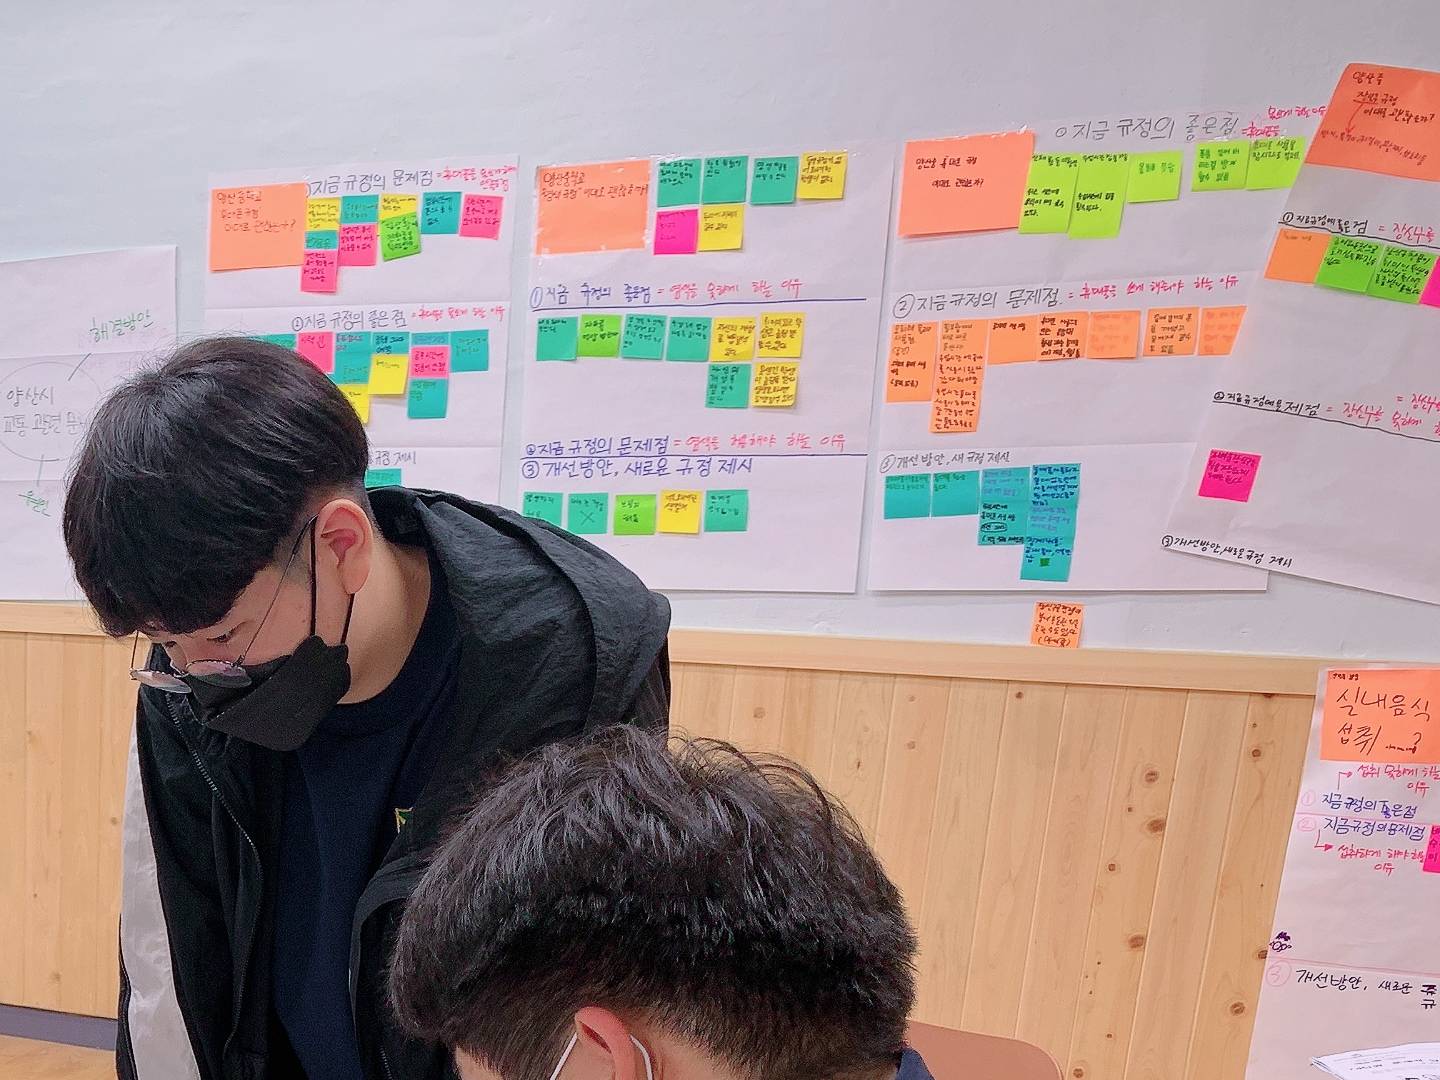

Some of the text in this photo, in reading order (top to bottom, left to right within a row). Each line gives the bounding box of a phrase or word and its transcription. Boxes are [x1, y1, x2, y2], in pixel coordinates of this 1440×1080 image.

[1073, 119, 1110, 140] 지금
[1115, 116, 1176, 140] 규정의
[393, 169, 434, 187] 문제점
[545, 283, 570, 306] 지금
[780, 278, 803, 299] 이유
[1219, 275, 1240, 290] 이유
[304, 312, 327, 329] 지금
[329, 309, 364, 329] 규정의
[5, 386, 55, 408] 양산시
[3, 412, 29, 437] 교통
[568, 437, 613, 456] 규정의
[616, 435, 670, 456] 문제점
[820, 432, 846, 452] 이유
[624, 459, 671, 477] 새로운
[675, 458, 712, 477] 규정
[718, 457, 753, 475] 제시
[1406, 780, 1430, 799] 이유
[1373, 862, 1395, 877] 이유
